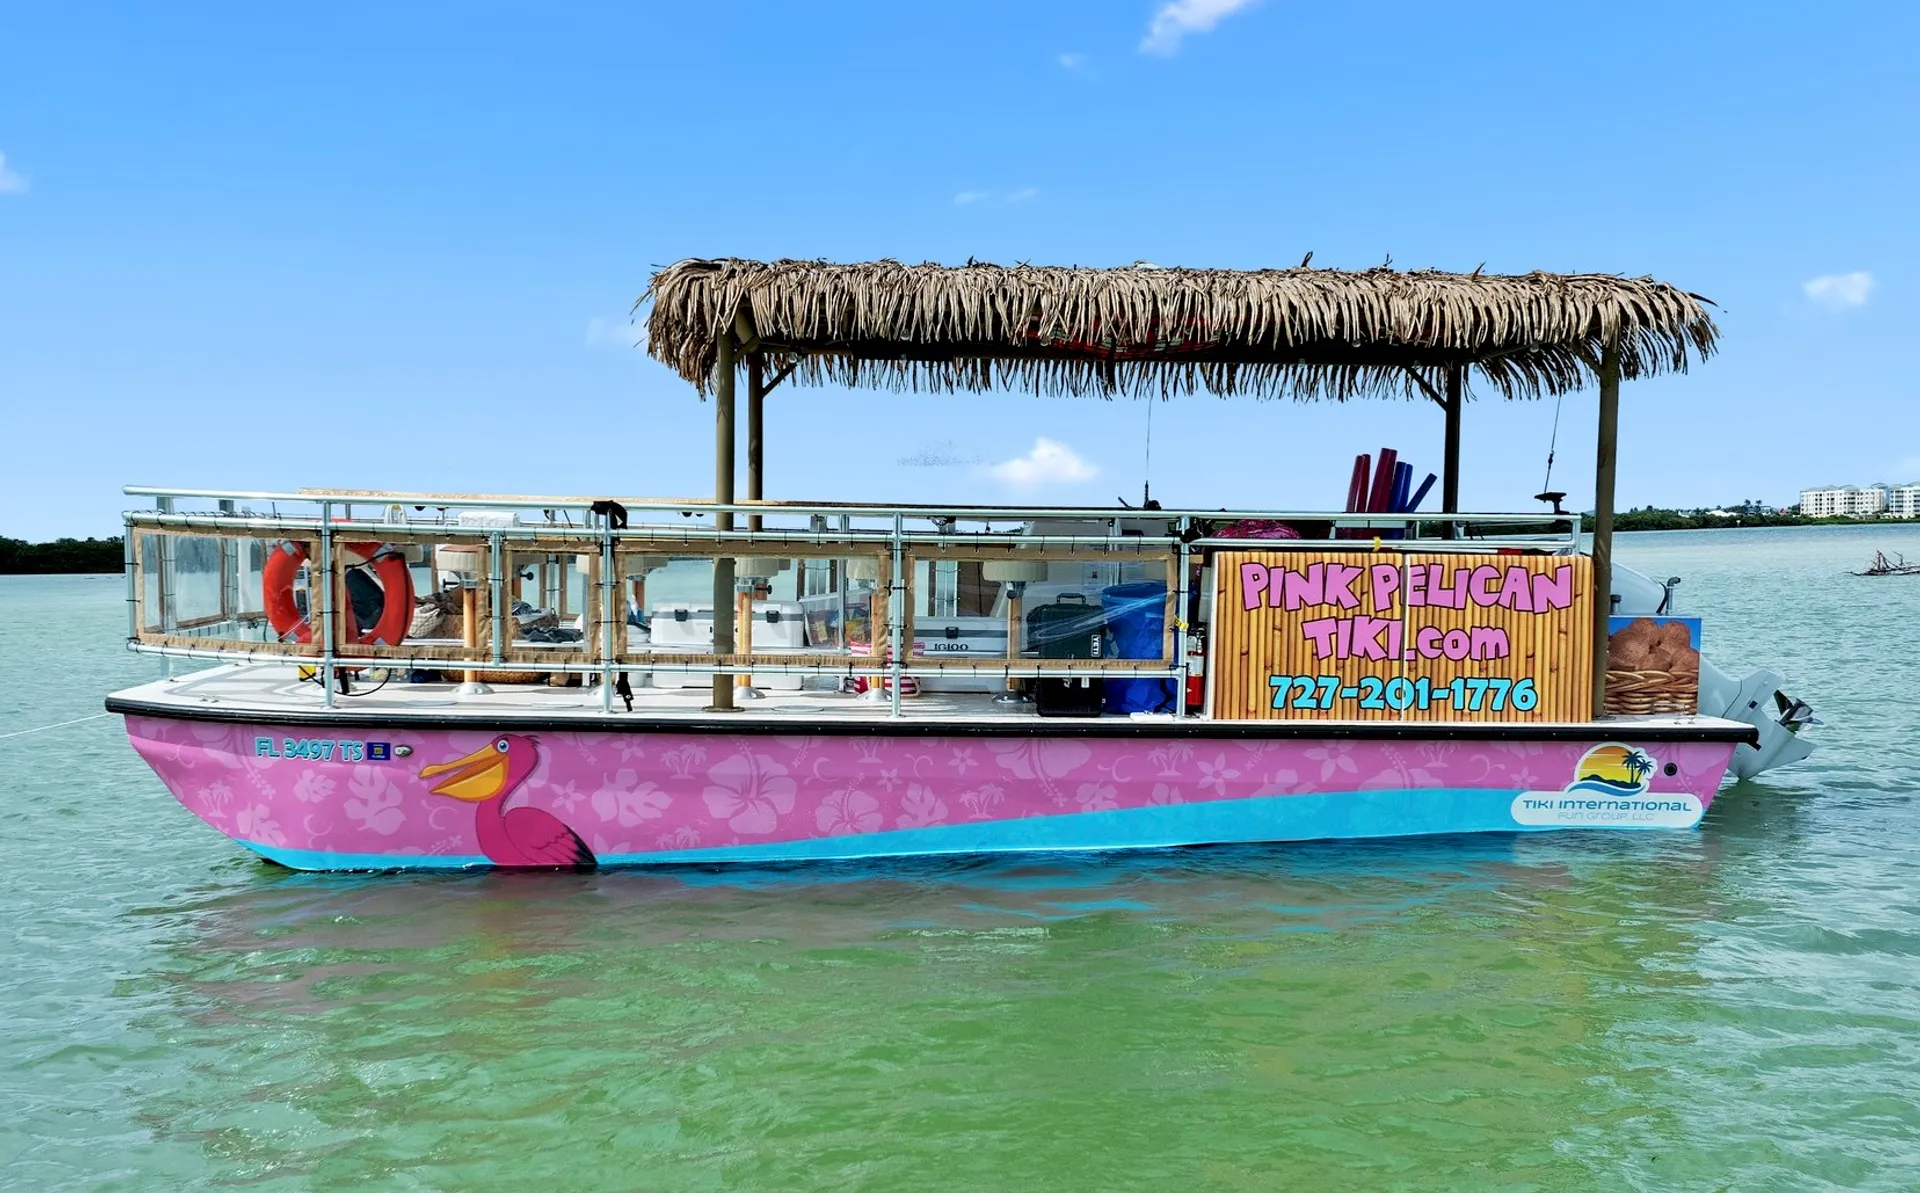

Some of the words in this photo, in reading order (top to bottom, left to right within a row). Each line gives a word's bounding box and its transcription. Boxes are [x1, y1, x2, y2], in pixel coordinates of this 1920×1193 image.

[1240, 562, 1364, 612] PINK
[1371, 563, 1572, 614] PELICAN
[1091, 636, 1100, 655] YETI
[1301, 615, 1510, 662] TIKI.com
[1269, 675, 1538, 711] 727-201-1776
[255, 737, 281, 758] FL
[283, 738, 336, 762] 3497
[339, 740, 364, 762] TS
[1523, 799, 1553, 809] TIKI
[1632, 812, 1655, 822] LLC
